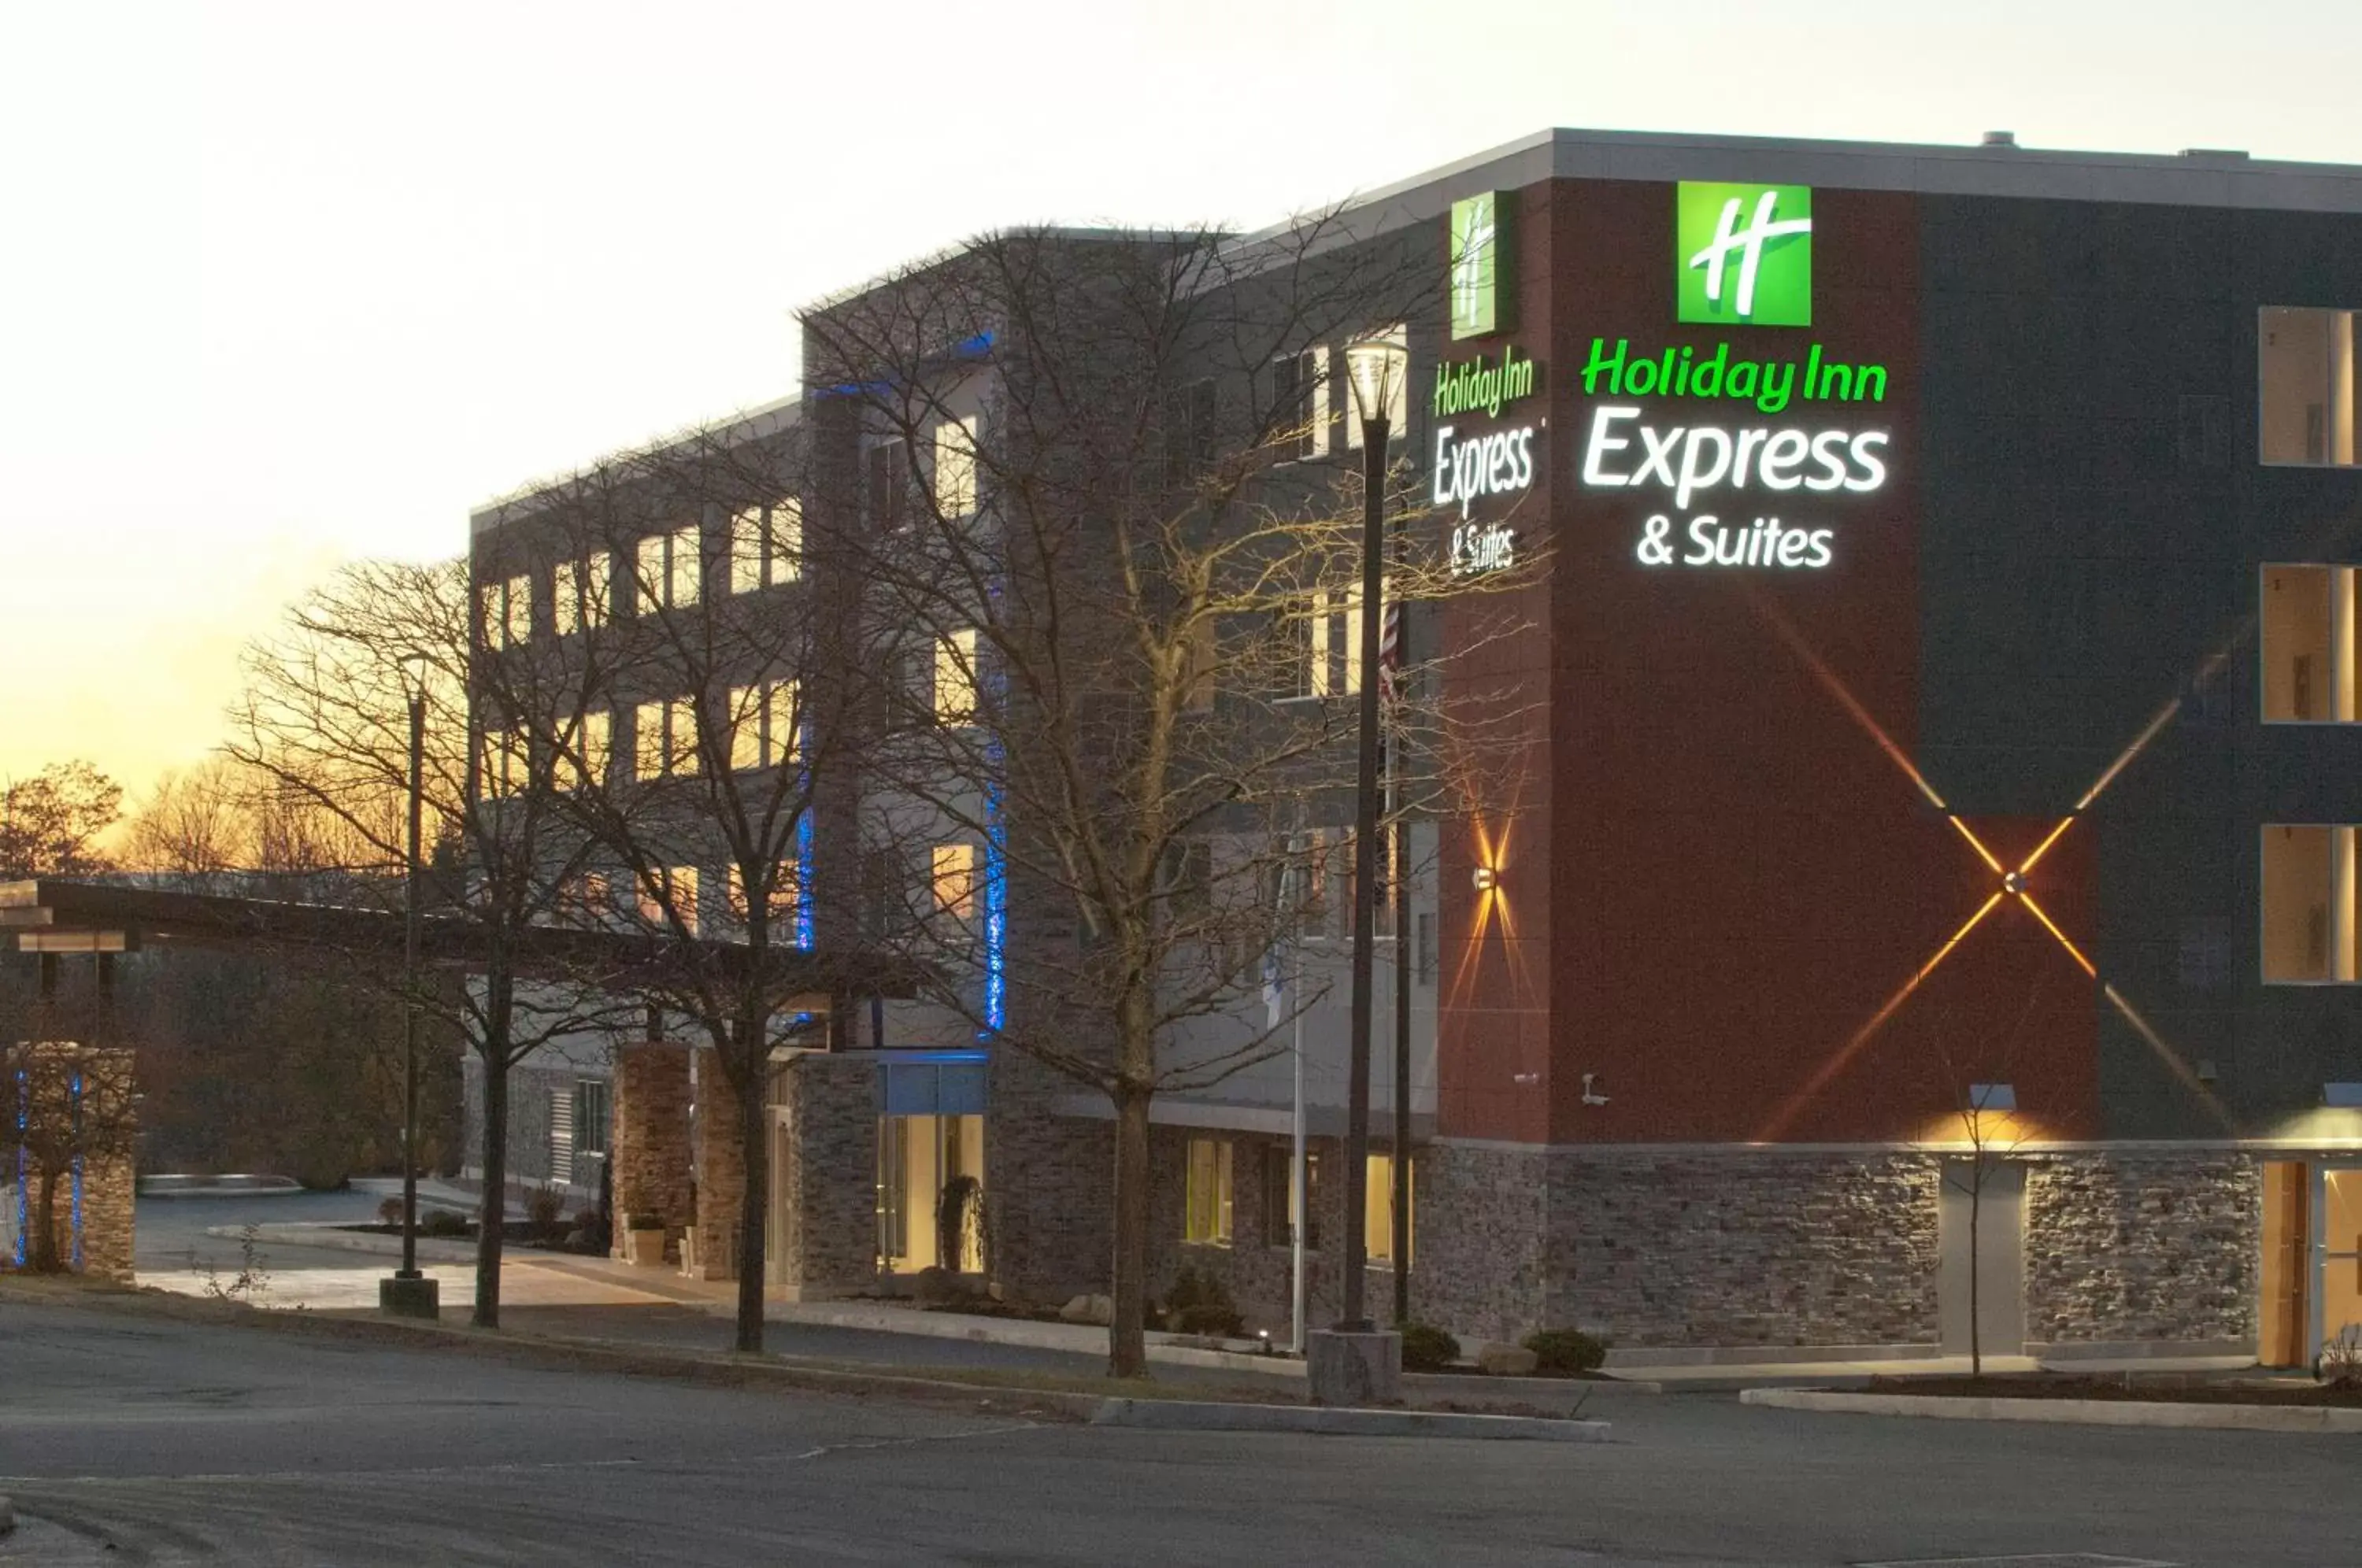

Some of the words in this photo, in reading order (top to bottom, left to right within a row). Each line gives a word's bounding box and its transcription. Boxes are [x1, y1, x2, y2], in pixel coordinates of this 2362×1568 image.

[1434, 354, 1500, 419] Holiday
[1504, 344, 1534, 400] Inn
[1580, 338, 1796, 413] Holiday
[1804, 344, 1887, 401] Inn
[1434, 426, 1533, 520] Express
[1582, 405, 1889, 509] Express
[1451, 526, 1464, 577] &
[1464, 523, 1514, 575] Suites
[1637, 516, 1674, 566] &
[1685, 516, 1833, 568] Suites
